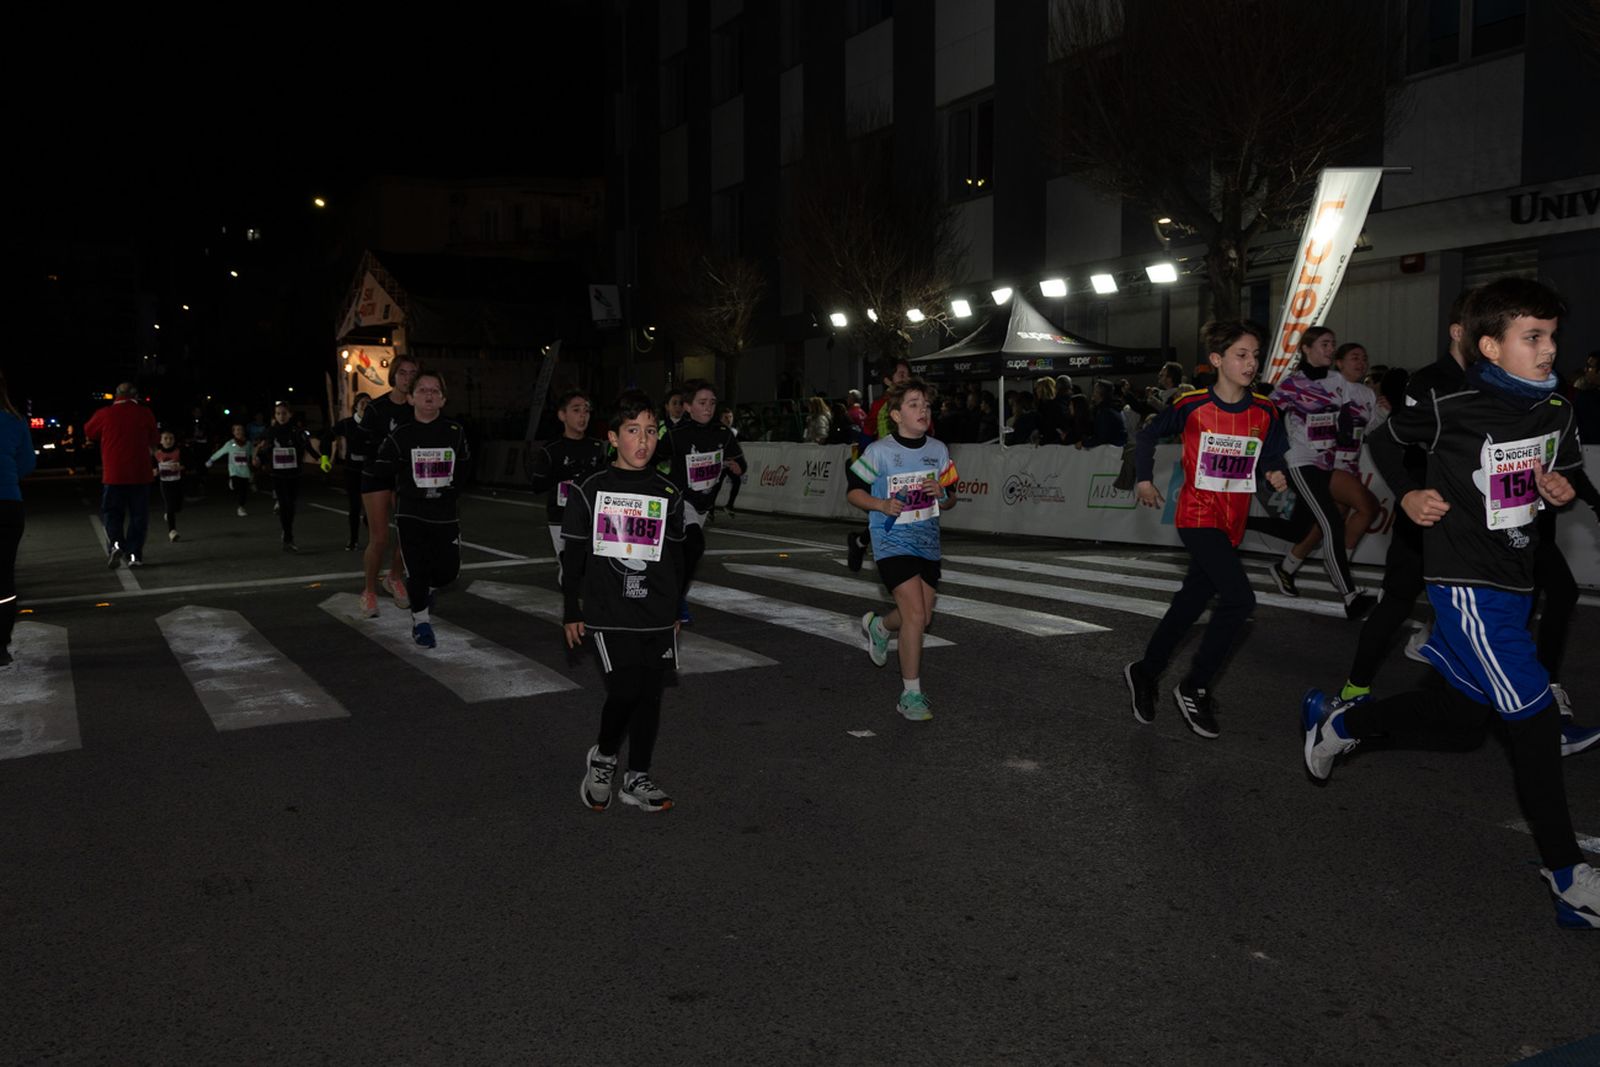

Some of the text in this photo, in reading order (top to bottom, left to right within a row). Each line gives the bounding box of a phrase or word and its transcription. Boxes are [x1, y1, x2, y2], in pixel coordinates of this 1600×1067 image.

[1506, 188, 1600, 225] UNIV
[1505, 450, 1532, 460] NOCHE
[1533, 447, 1541, 456] DE
[803, 461, 831, 478] XAVE
[1496, 458, 1538, 473] SAN ANT
[612, 500, 633, 508] NOCHE
